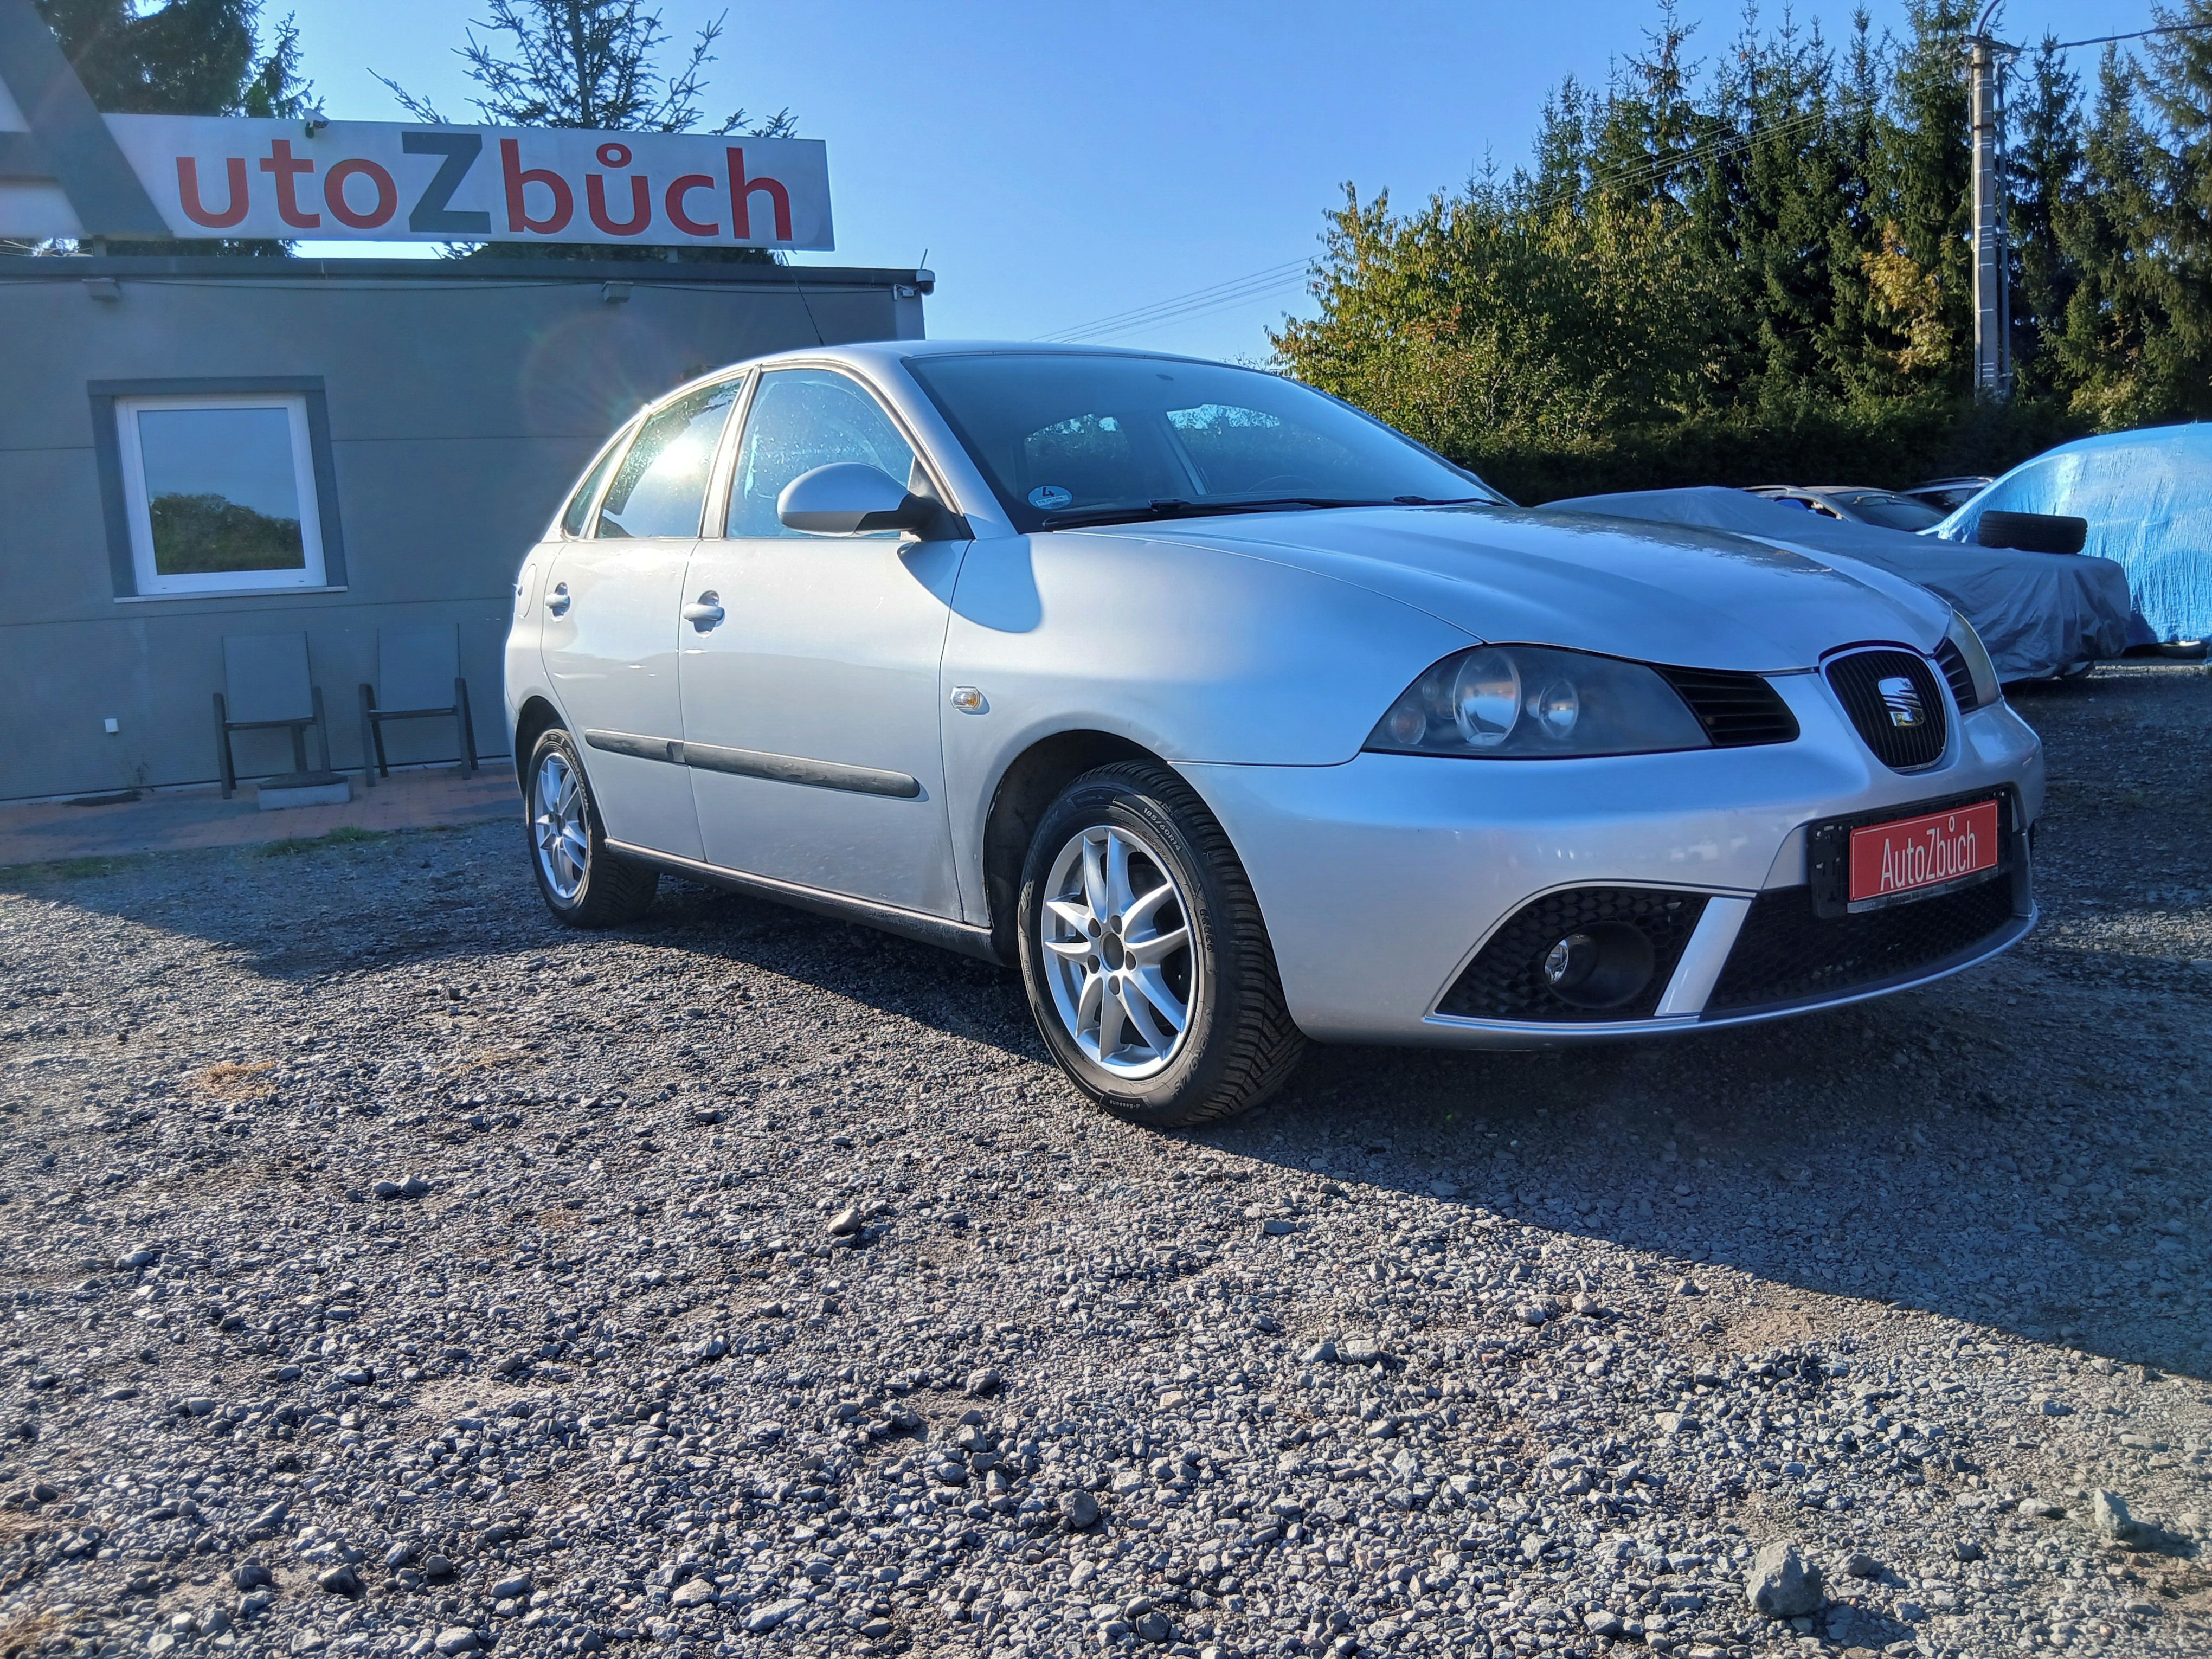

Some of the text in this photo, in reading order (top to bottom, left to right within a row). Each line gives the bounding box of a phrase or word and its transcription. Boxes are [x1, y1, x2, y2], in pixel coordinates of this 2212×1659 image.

[1042, 486, 1054, 497] 4
[1143, 807, 1182, 851] 185/60R14
[1880, 815, 1976, 892] AutoZbůch
